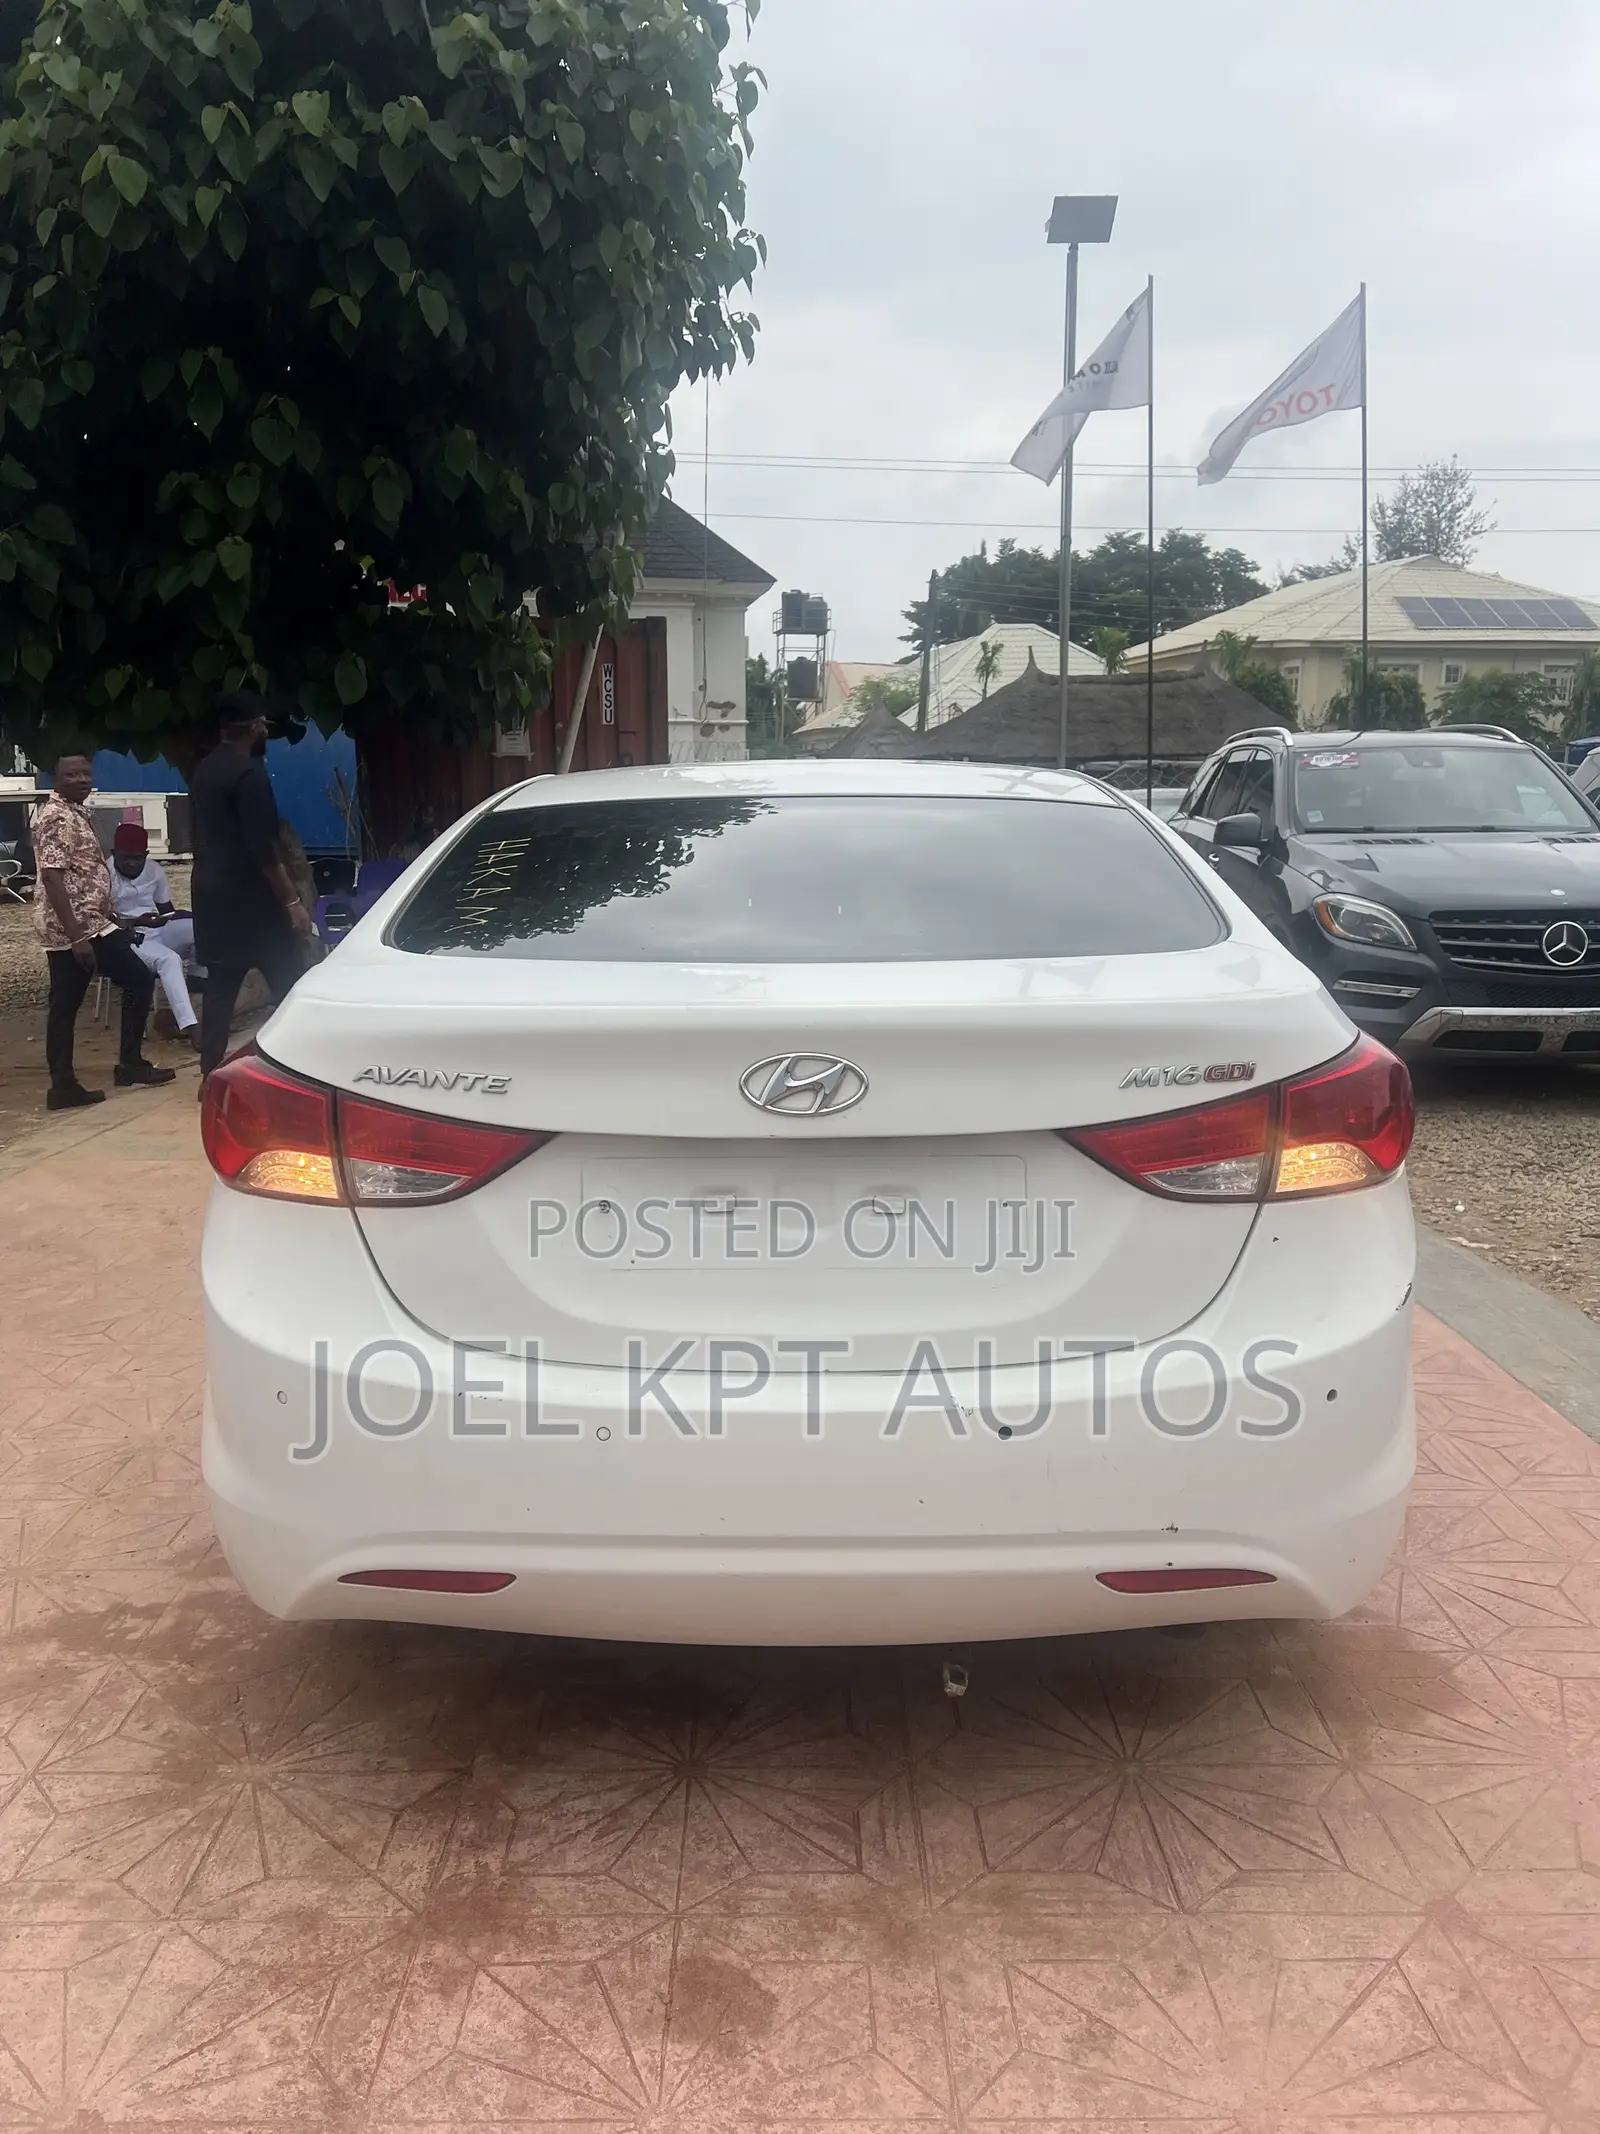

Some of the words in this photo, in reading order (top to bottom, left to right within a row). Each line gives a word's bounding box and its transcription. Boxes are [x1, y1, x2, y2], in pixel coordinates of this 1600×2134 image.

[602, 663, 614, 724] WCSU
[352, 1064, 512, 1094] AVANTE
[1118, 1064, 1202, 1089] M16
